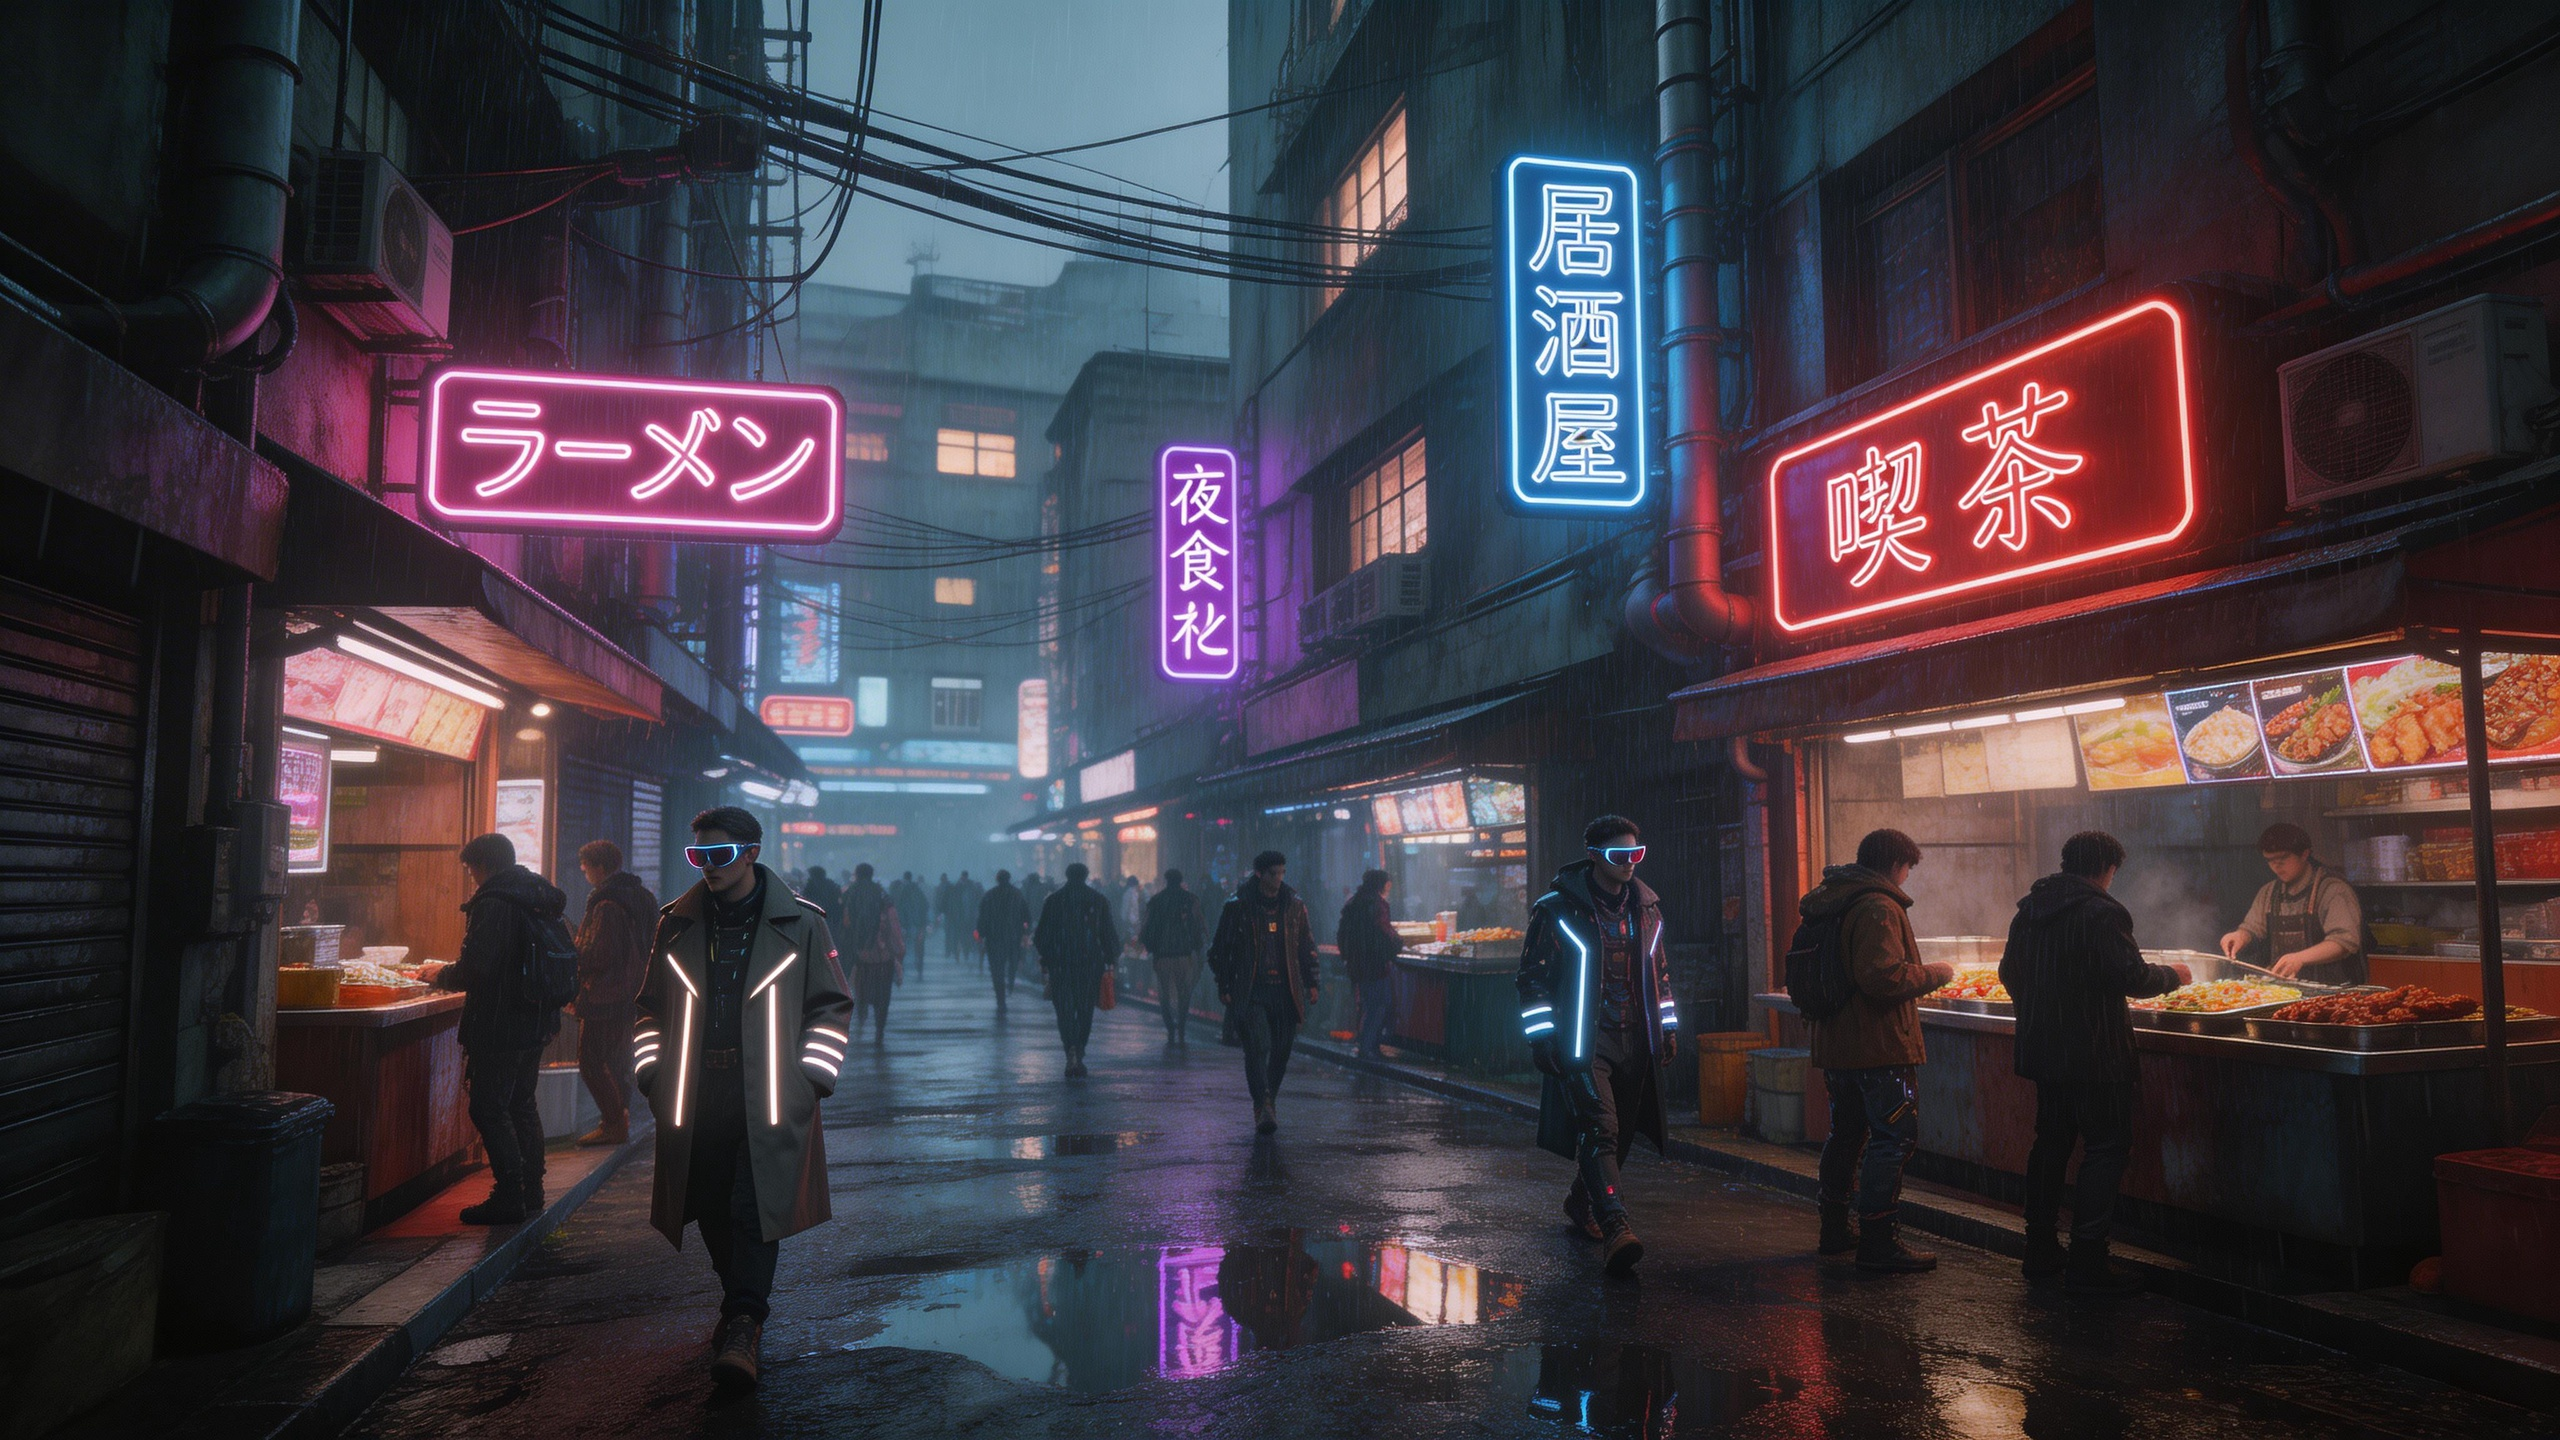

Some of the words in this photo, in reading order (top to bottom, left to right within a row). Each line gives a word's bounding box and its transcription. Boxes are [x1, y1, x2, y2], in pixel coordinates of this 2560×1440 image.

[1529, 183, 1626, 484] 居酒屋
[461, 400, 815, 501] ラーメン
[1827, 382, 2083, 587] 喫茶
